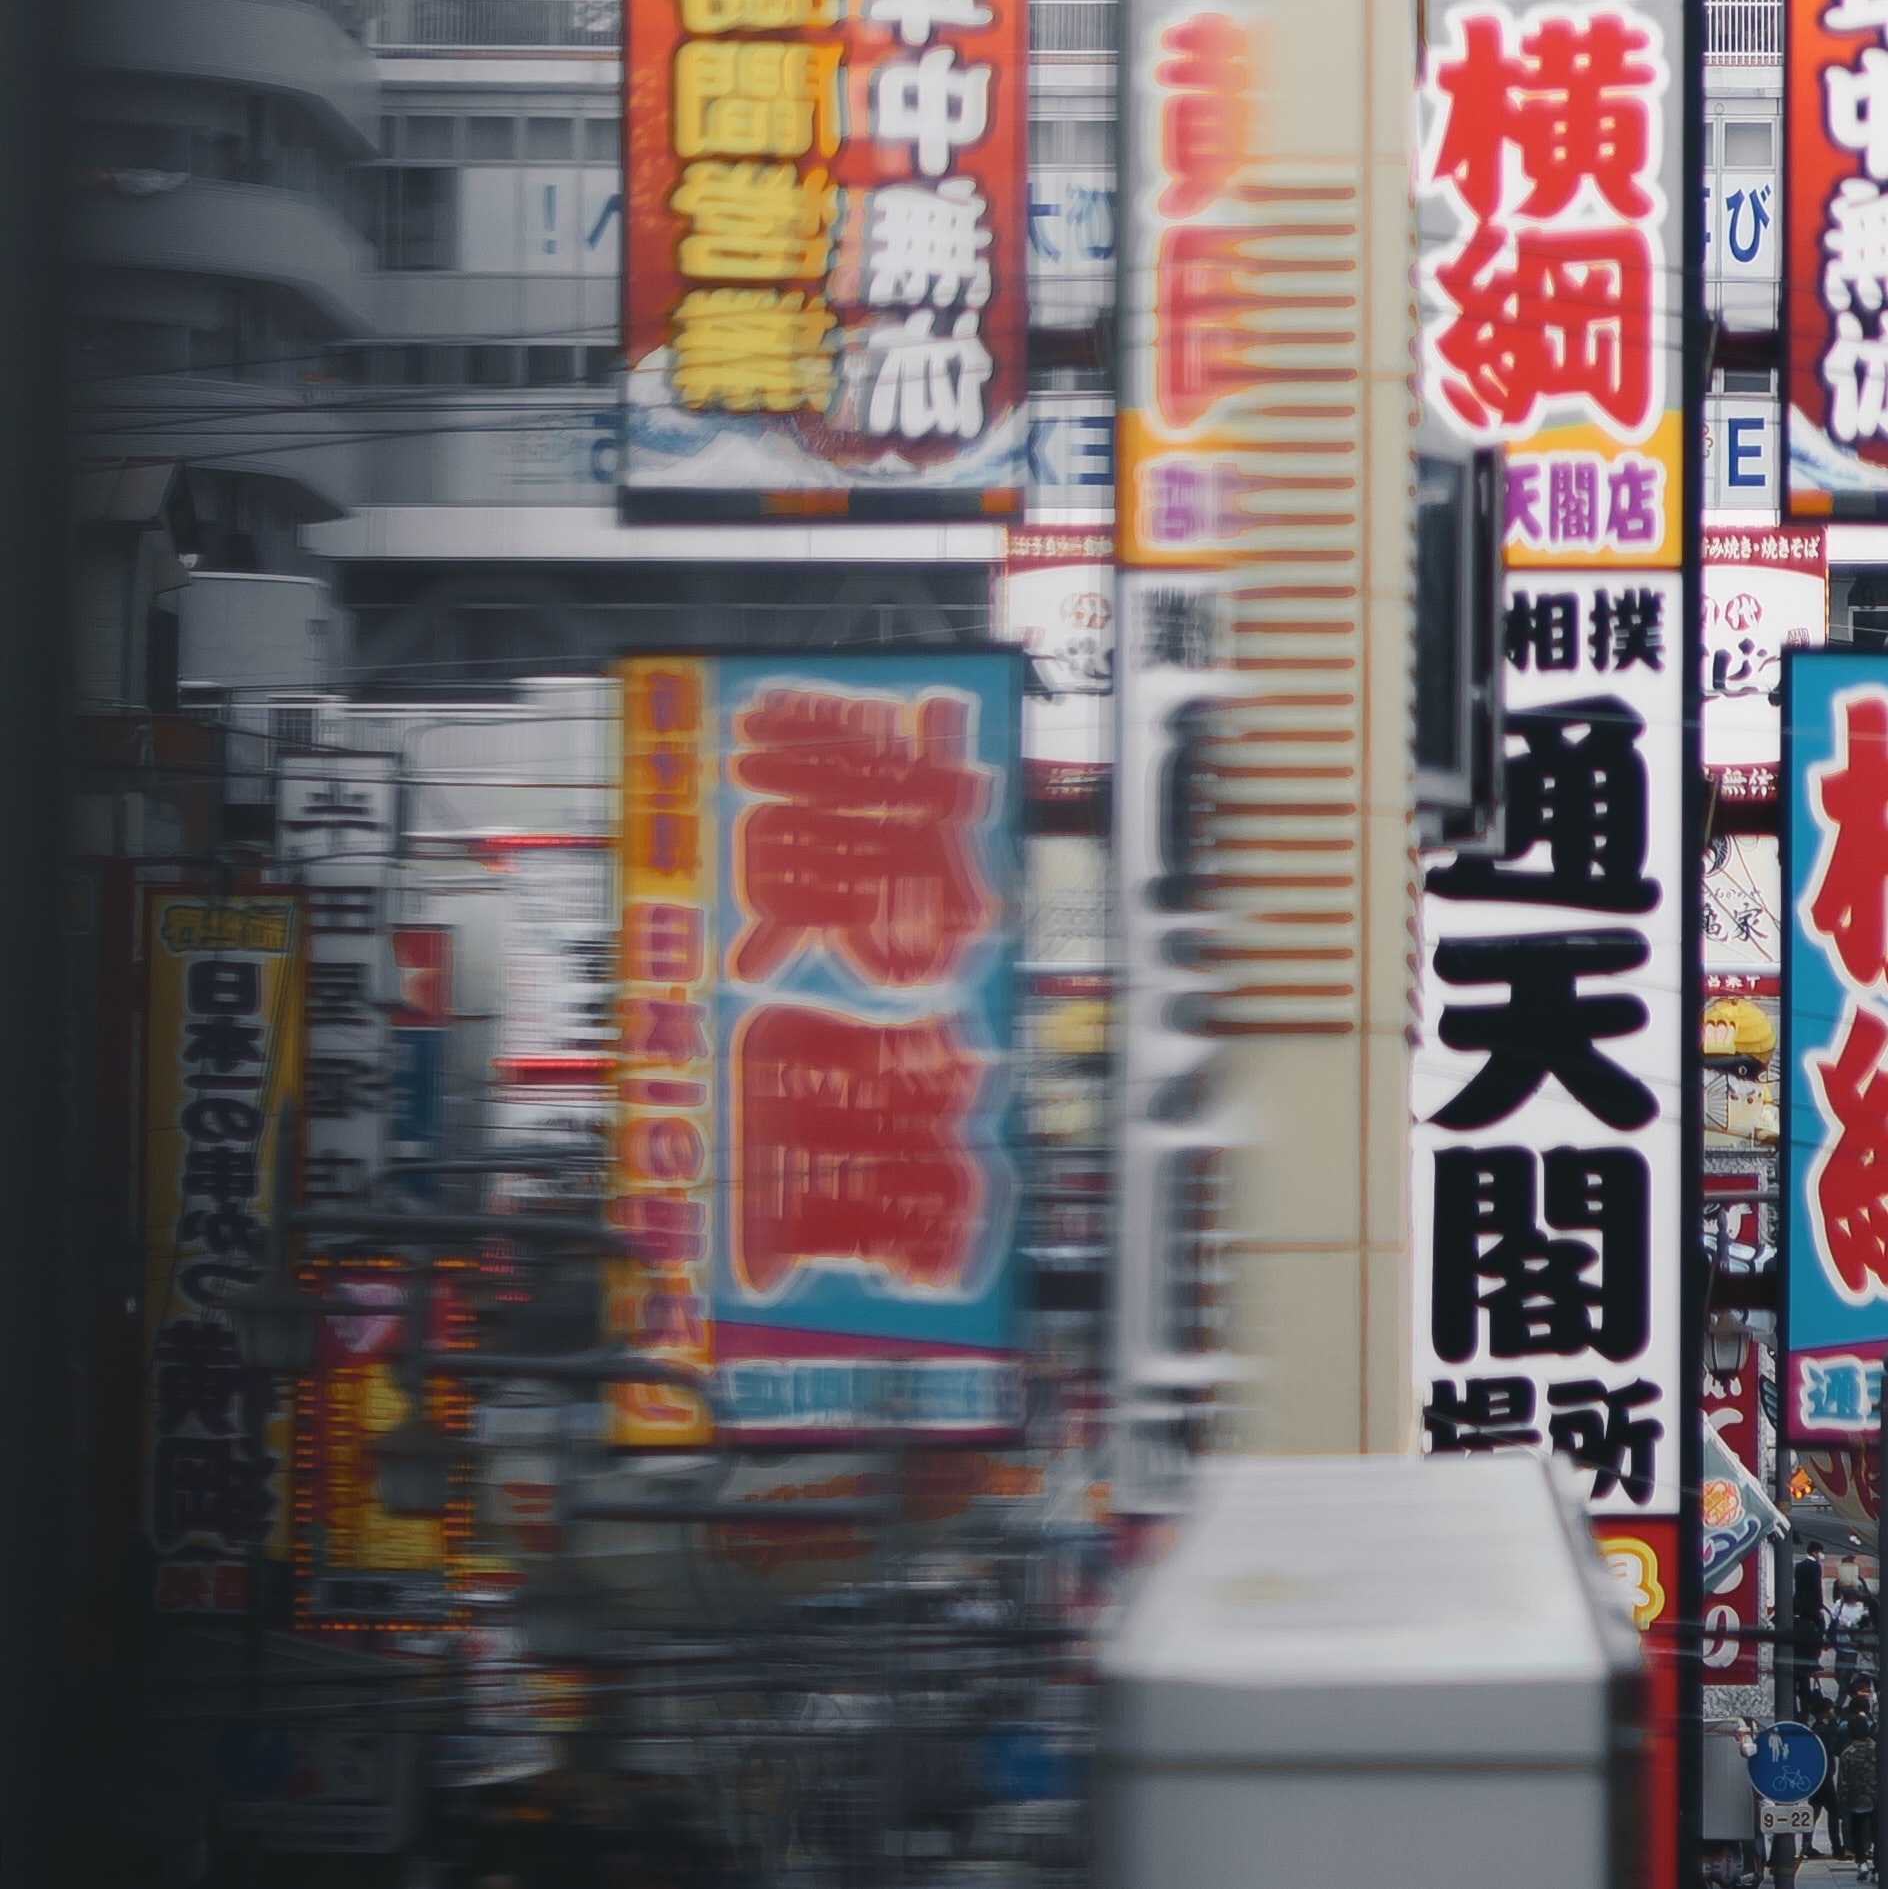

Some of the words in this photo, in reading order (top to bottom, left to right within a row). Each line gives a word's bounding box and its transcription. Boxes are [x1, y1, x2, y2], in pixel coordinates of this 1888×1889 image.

[1433, 15, 1656, 431] 横綱
[1503, 589, 1664, 674] 相撲
[1426, 693, 1661, 1364] 通天閣
[1764, 1809, 1811, 1829] 9-22
